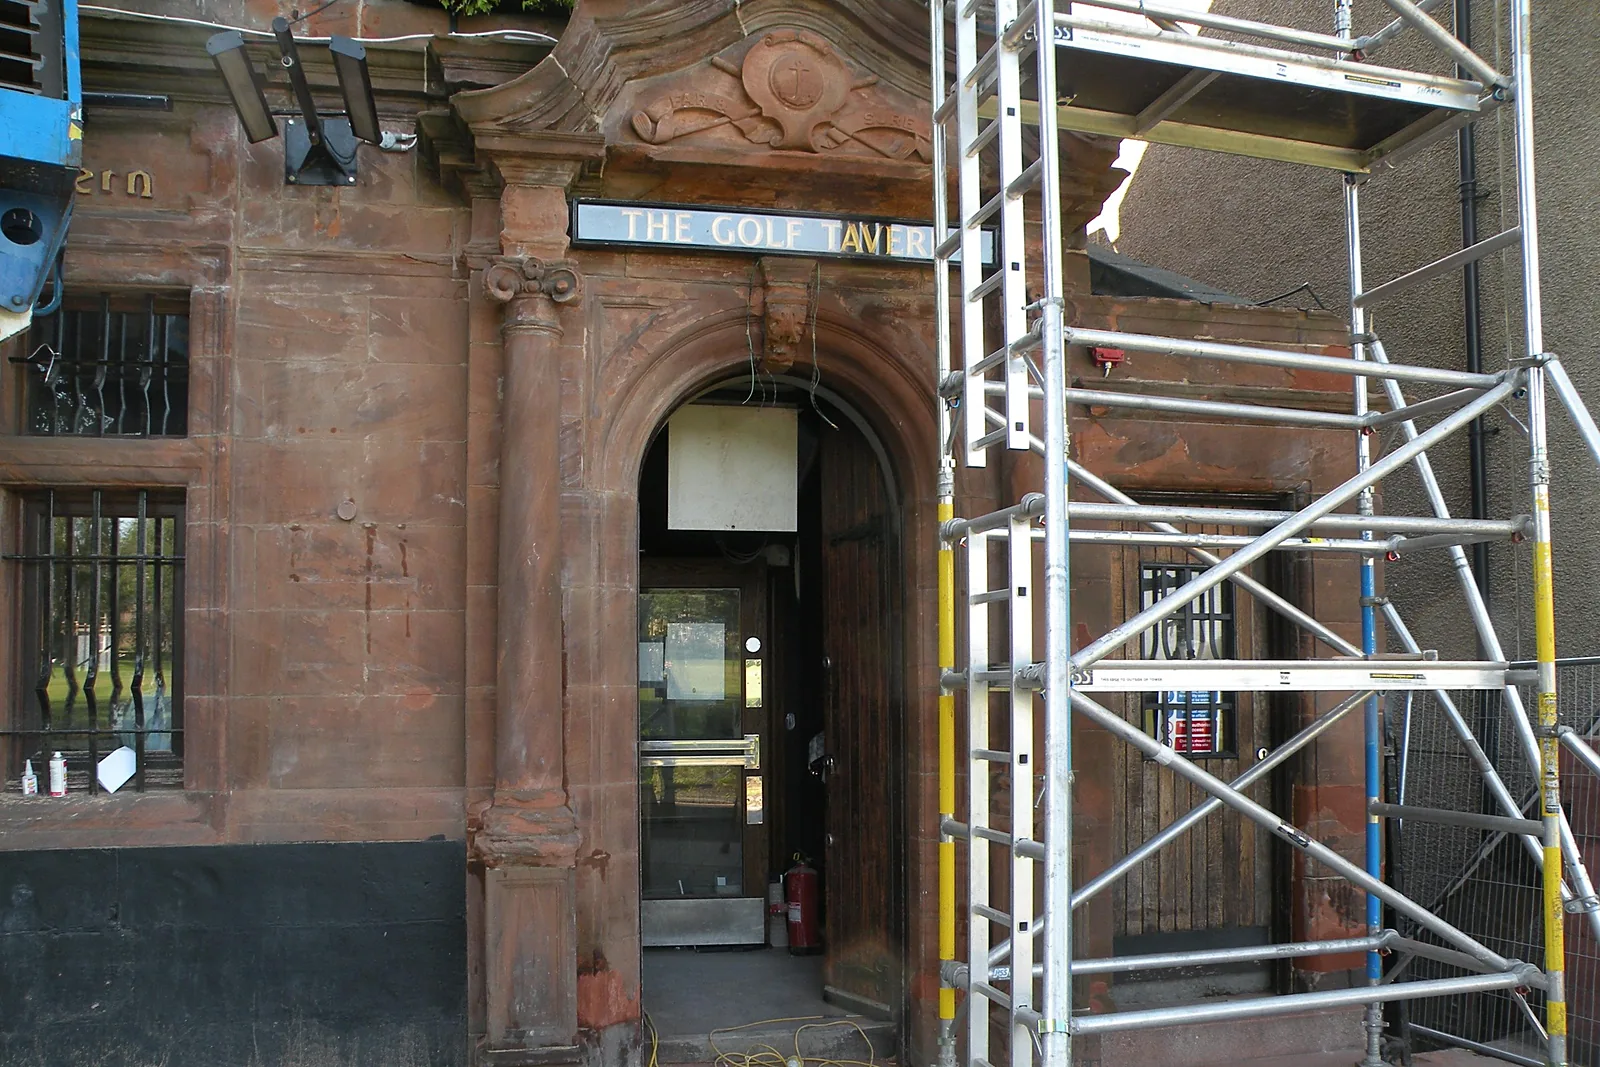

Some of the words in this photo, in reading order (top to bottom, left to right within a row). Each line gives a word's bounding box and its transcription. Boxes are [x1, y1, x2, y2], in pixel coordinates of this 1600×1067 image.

[621, 209, 694, 243] THE
[711, 214, 805, 249] GOLF
[821, 221, 936, 258] TAVER
